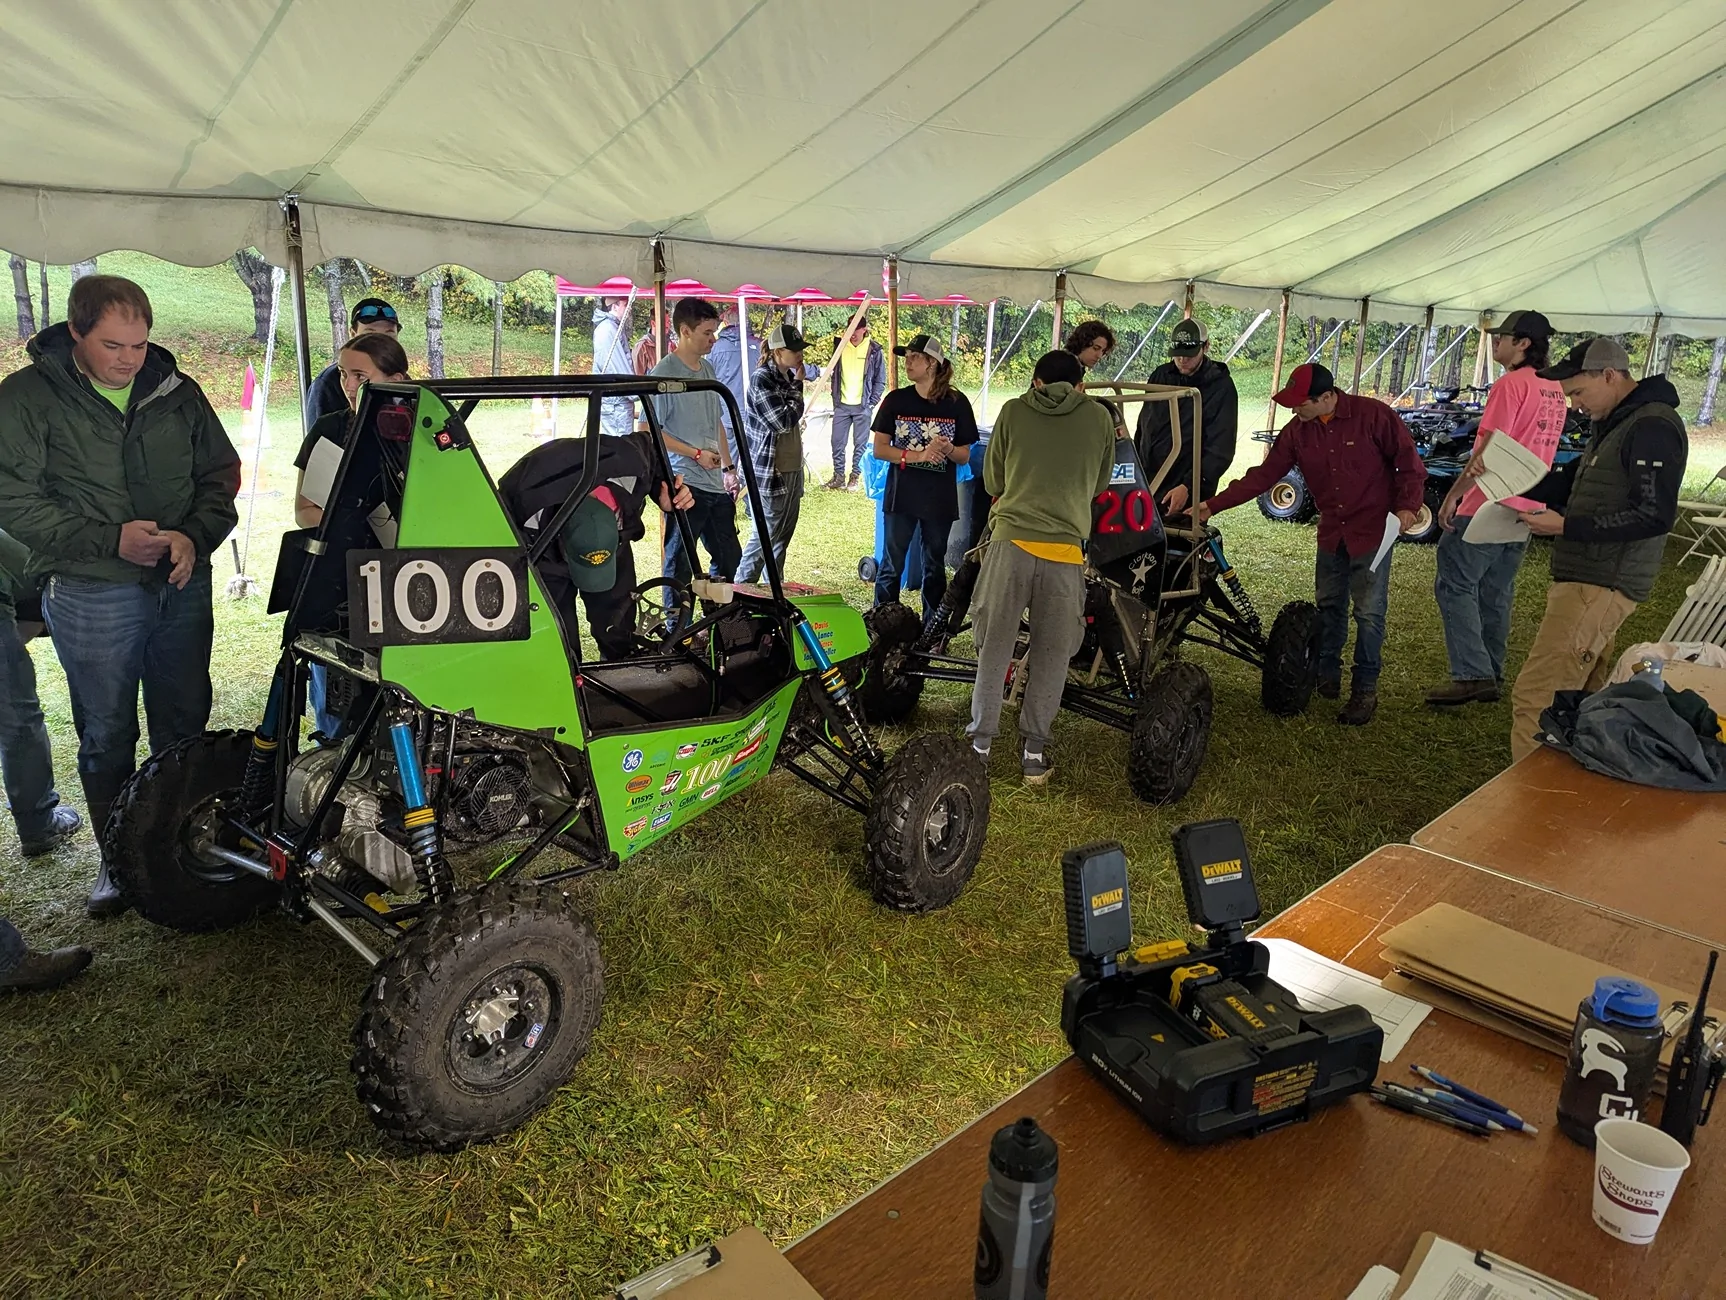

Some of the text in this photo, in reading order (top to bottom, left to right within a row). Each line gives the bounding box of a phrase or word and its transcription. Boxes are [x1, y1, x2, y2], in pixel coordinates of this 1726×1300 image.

[1096, 489, 1154, 534] 20
[1128, 552, 1158, 570] Clarkson
[359, 558, 517, 634] 100
[701, 734, 731, 748] SKF
[681, 752, 734, 795] 100
[489, 793, 514, 803] KOHLER
[627, 793, 654, 807] Ansys
[1109, 1069, 1132, 1092] LITHIUM
